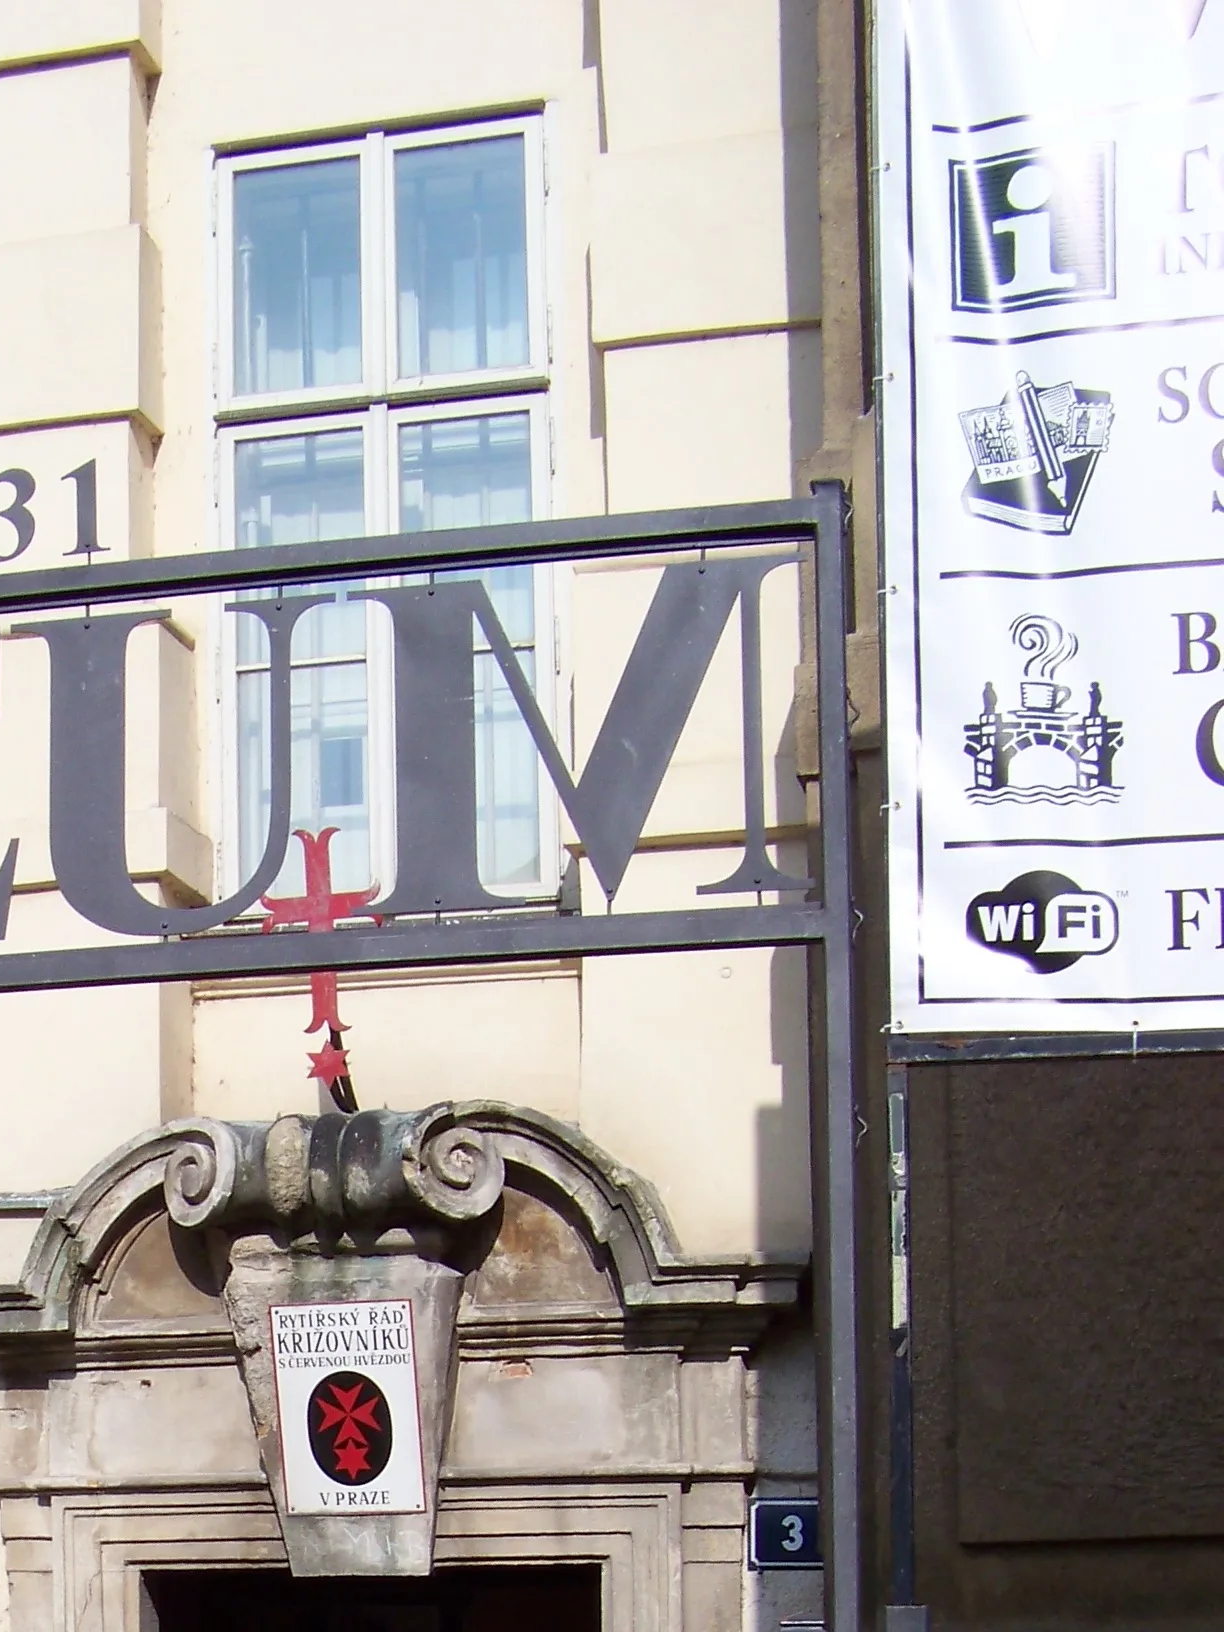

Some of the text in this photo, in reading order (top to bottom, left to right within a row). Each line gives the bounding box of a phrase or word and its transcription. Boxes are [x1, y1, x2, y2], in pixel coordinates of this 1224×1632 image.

[1170, 611, 1224, 675] B
[278, 1305, 404, 1330] RYTÍŘSKÝ ŘÁD
[276, 1322, 410, 1354] KŘIŽOVNÍKŮ
[278, 1350, 411, 1369] S ČERVENOU HVĚZDOU
[319, 1490, 391, 1506] V PRAZE
[781, 1514, 804, 1552] 3
